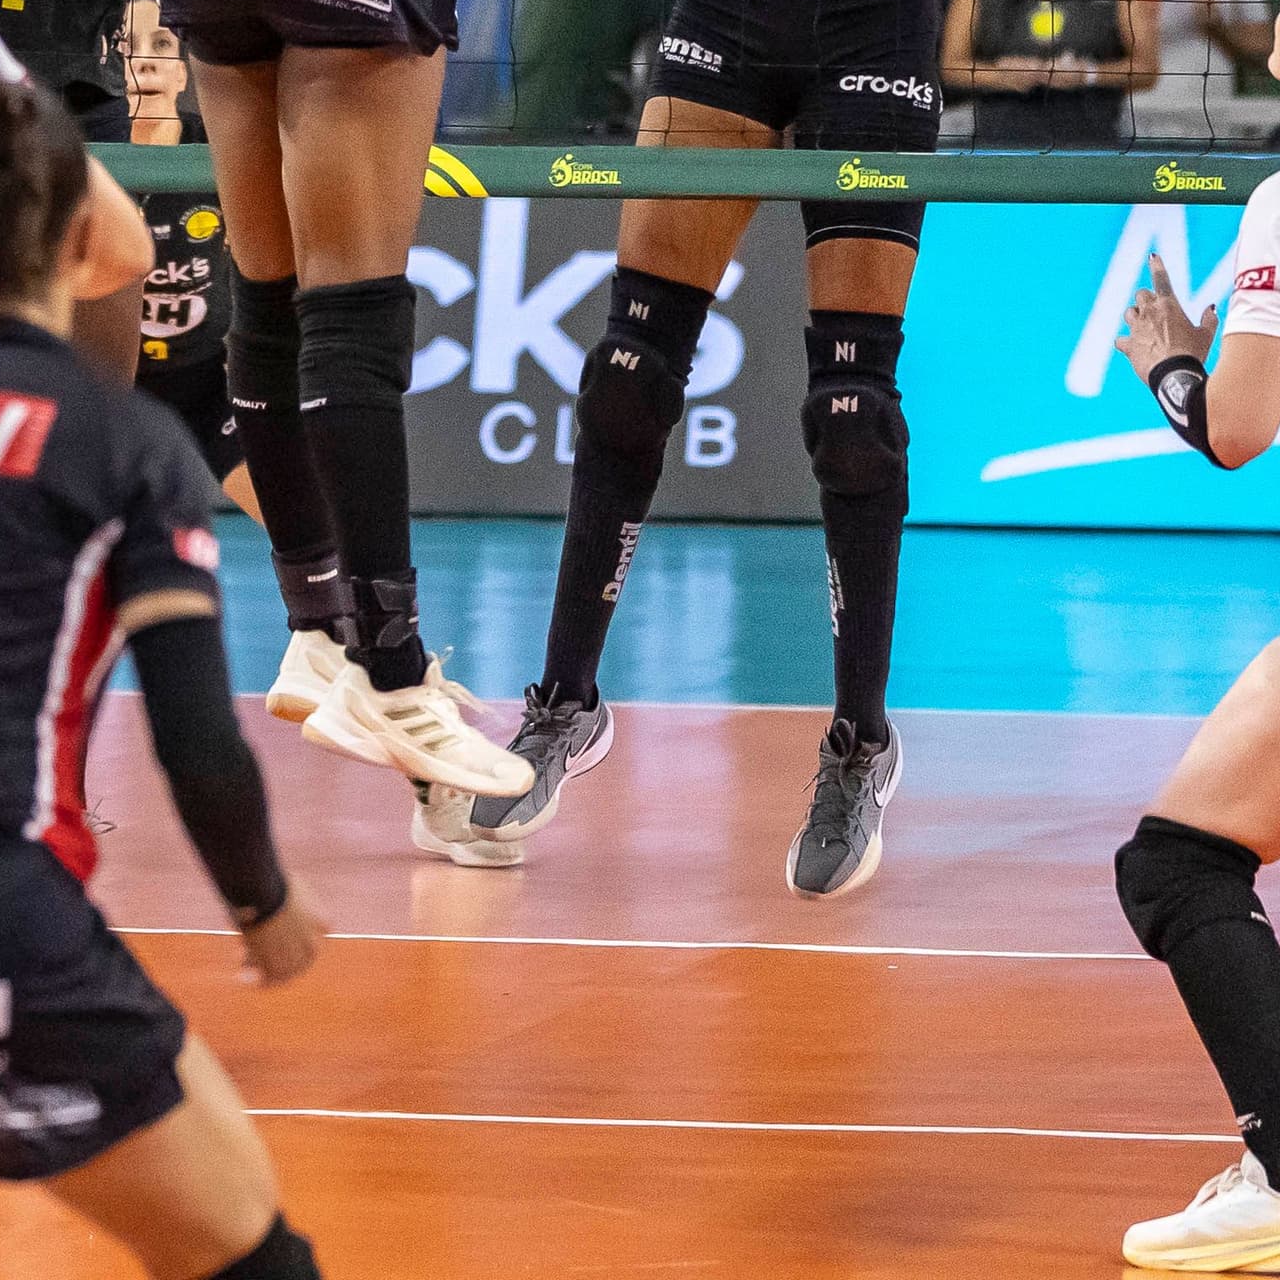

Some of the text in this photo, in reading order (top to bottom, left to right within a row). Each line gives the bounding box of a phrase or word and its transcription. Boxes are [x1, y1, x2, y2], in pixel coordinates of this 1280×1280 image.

[839, 74, 934, 104] crock's
[572, 169, 621, 185] BRASIL
[858, 175, 909, 189] BRASIL
[1177, 176, 1226, 190] BRASIL
[628, 299, 650, 320] N1
[609, 347, 641, 371] N1
[834, 340, 857, 363] N1
[831, 395, 859, 415] N1
[479, 400, 739, 469] CLB
[601, 521, 642, 602] Dentil
